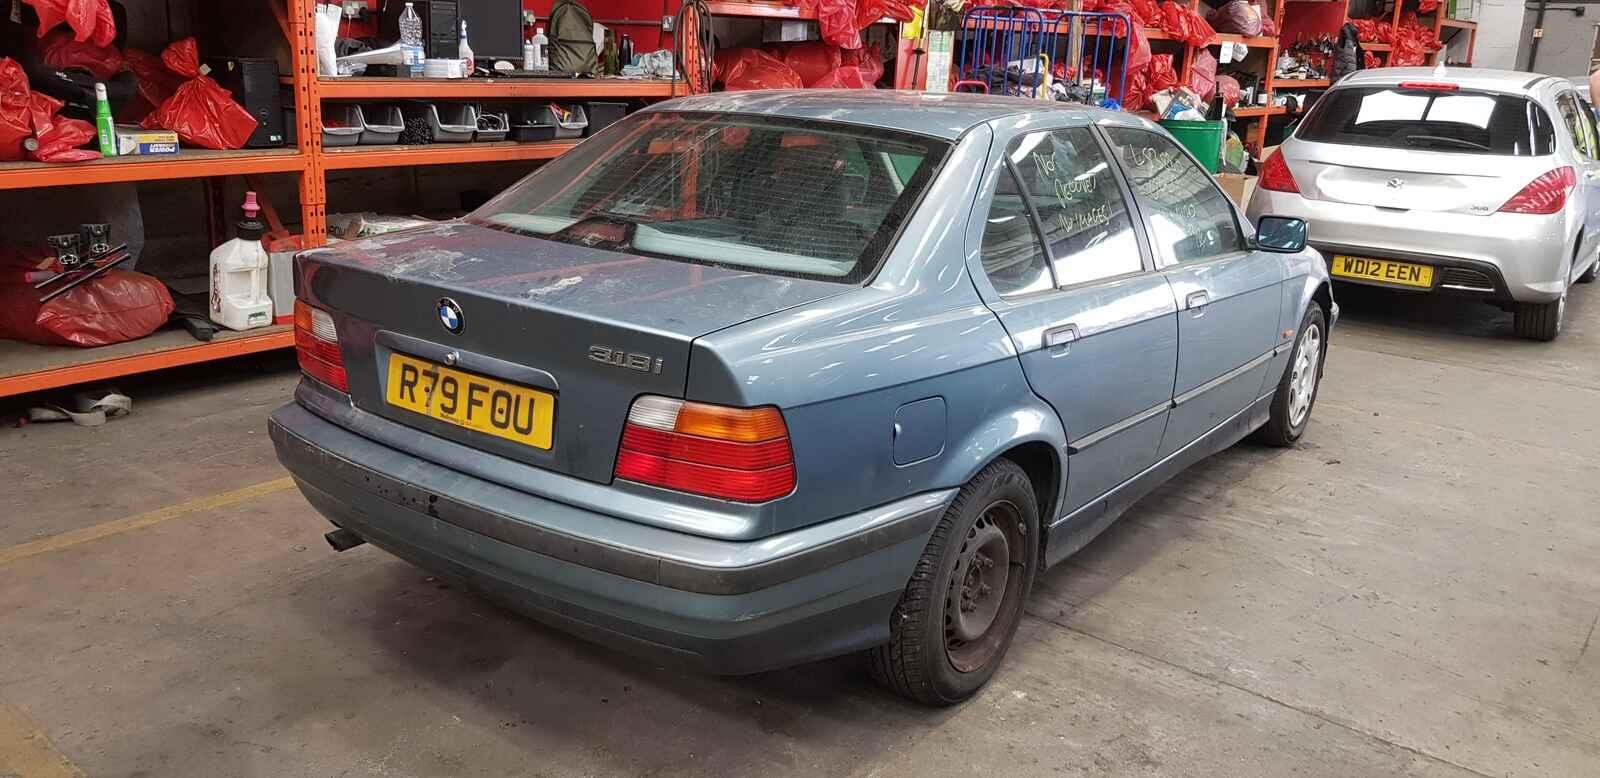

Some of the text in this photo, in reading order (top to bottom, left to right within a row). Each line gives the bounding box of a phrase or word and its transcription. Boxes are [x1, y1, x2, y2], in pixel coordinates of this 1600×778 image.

[1344, 256, 1421, 281] WD12 EEN
[588, 345, 664, 375] 318i
[400, 363, 535, 436] R79 FOU
